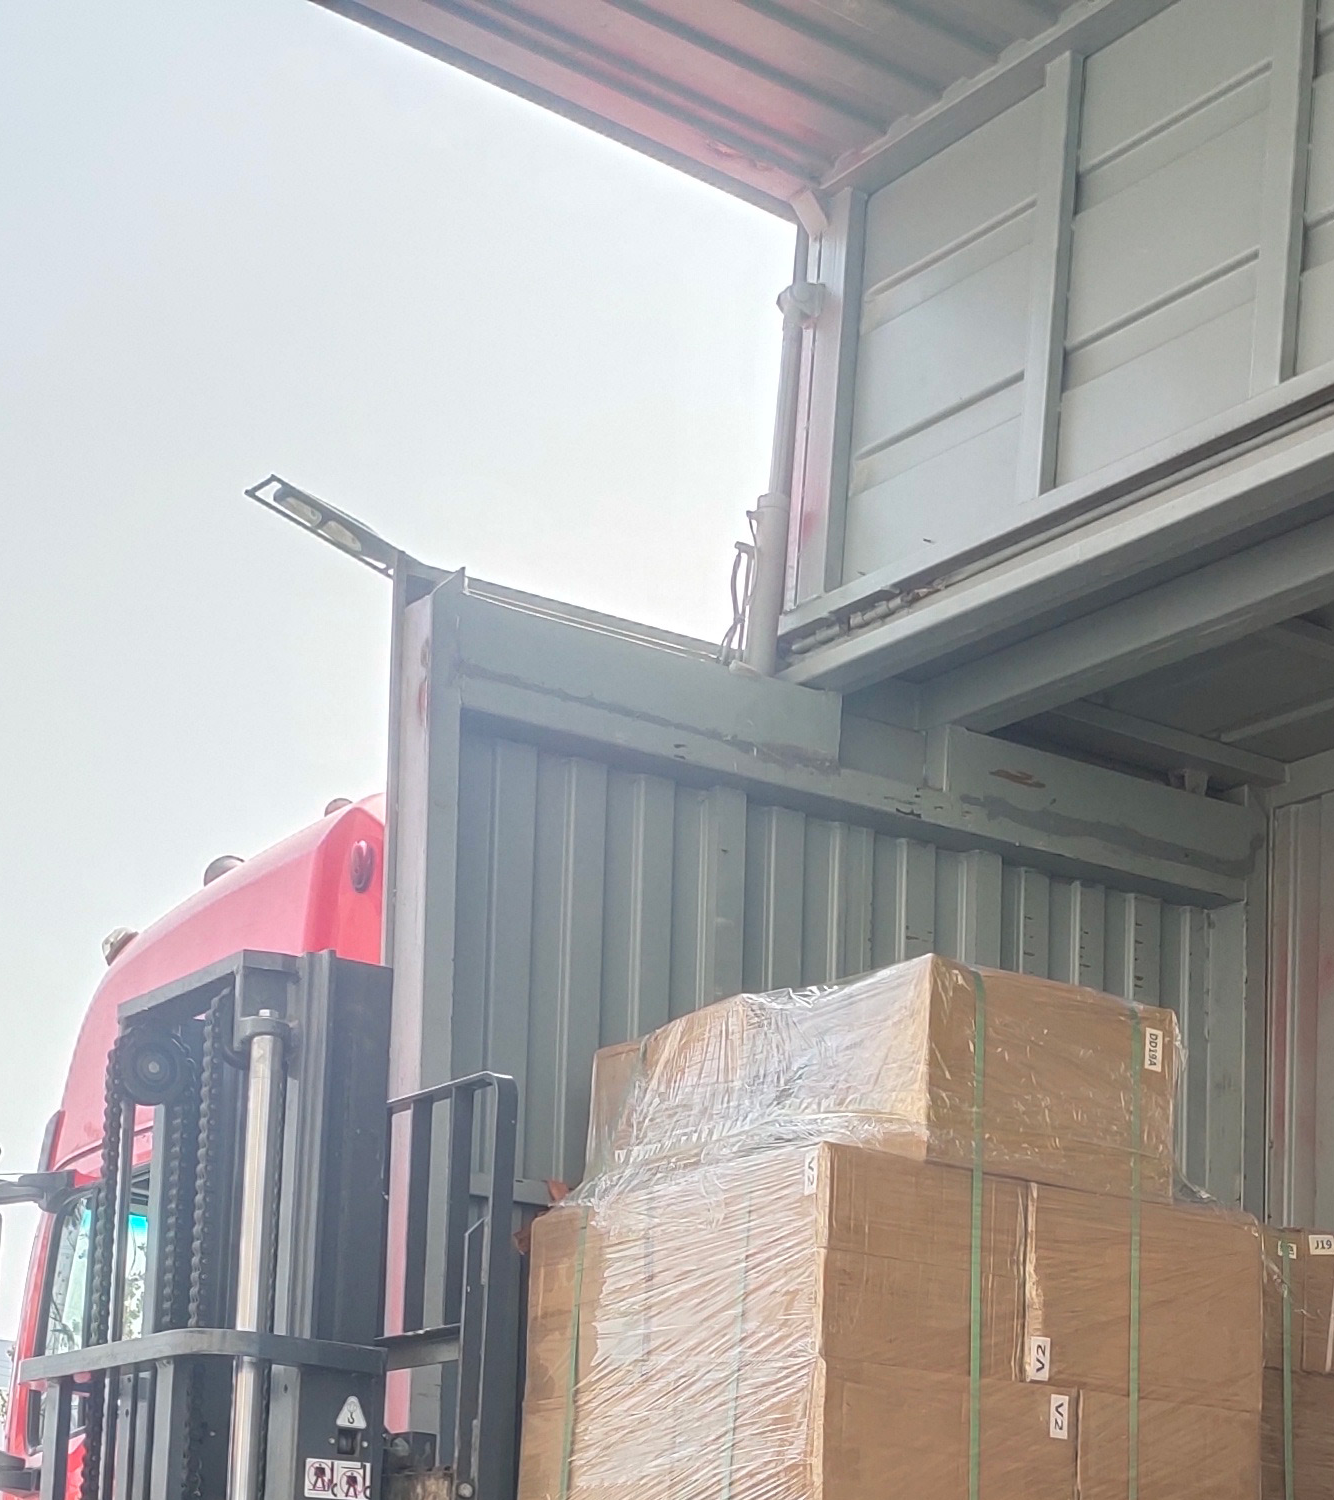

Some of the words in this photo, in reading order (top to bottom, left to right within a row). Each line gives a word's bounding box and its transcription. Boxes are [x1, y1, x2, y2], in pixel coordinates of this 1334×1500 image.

[807, 1156, 816, 1187] V2
[1314, 1239, 1332, 1250] J19
[1036, 1344, 1046, 1373] V2
[1054, 1402, 1064, 1431] V2
